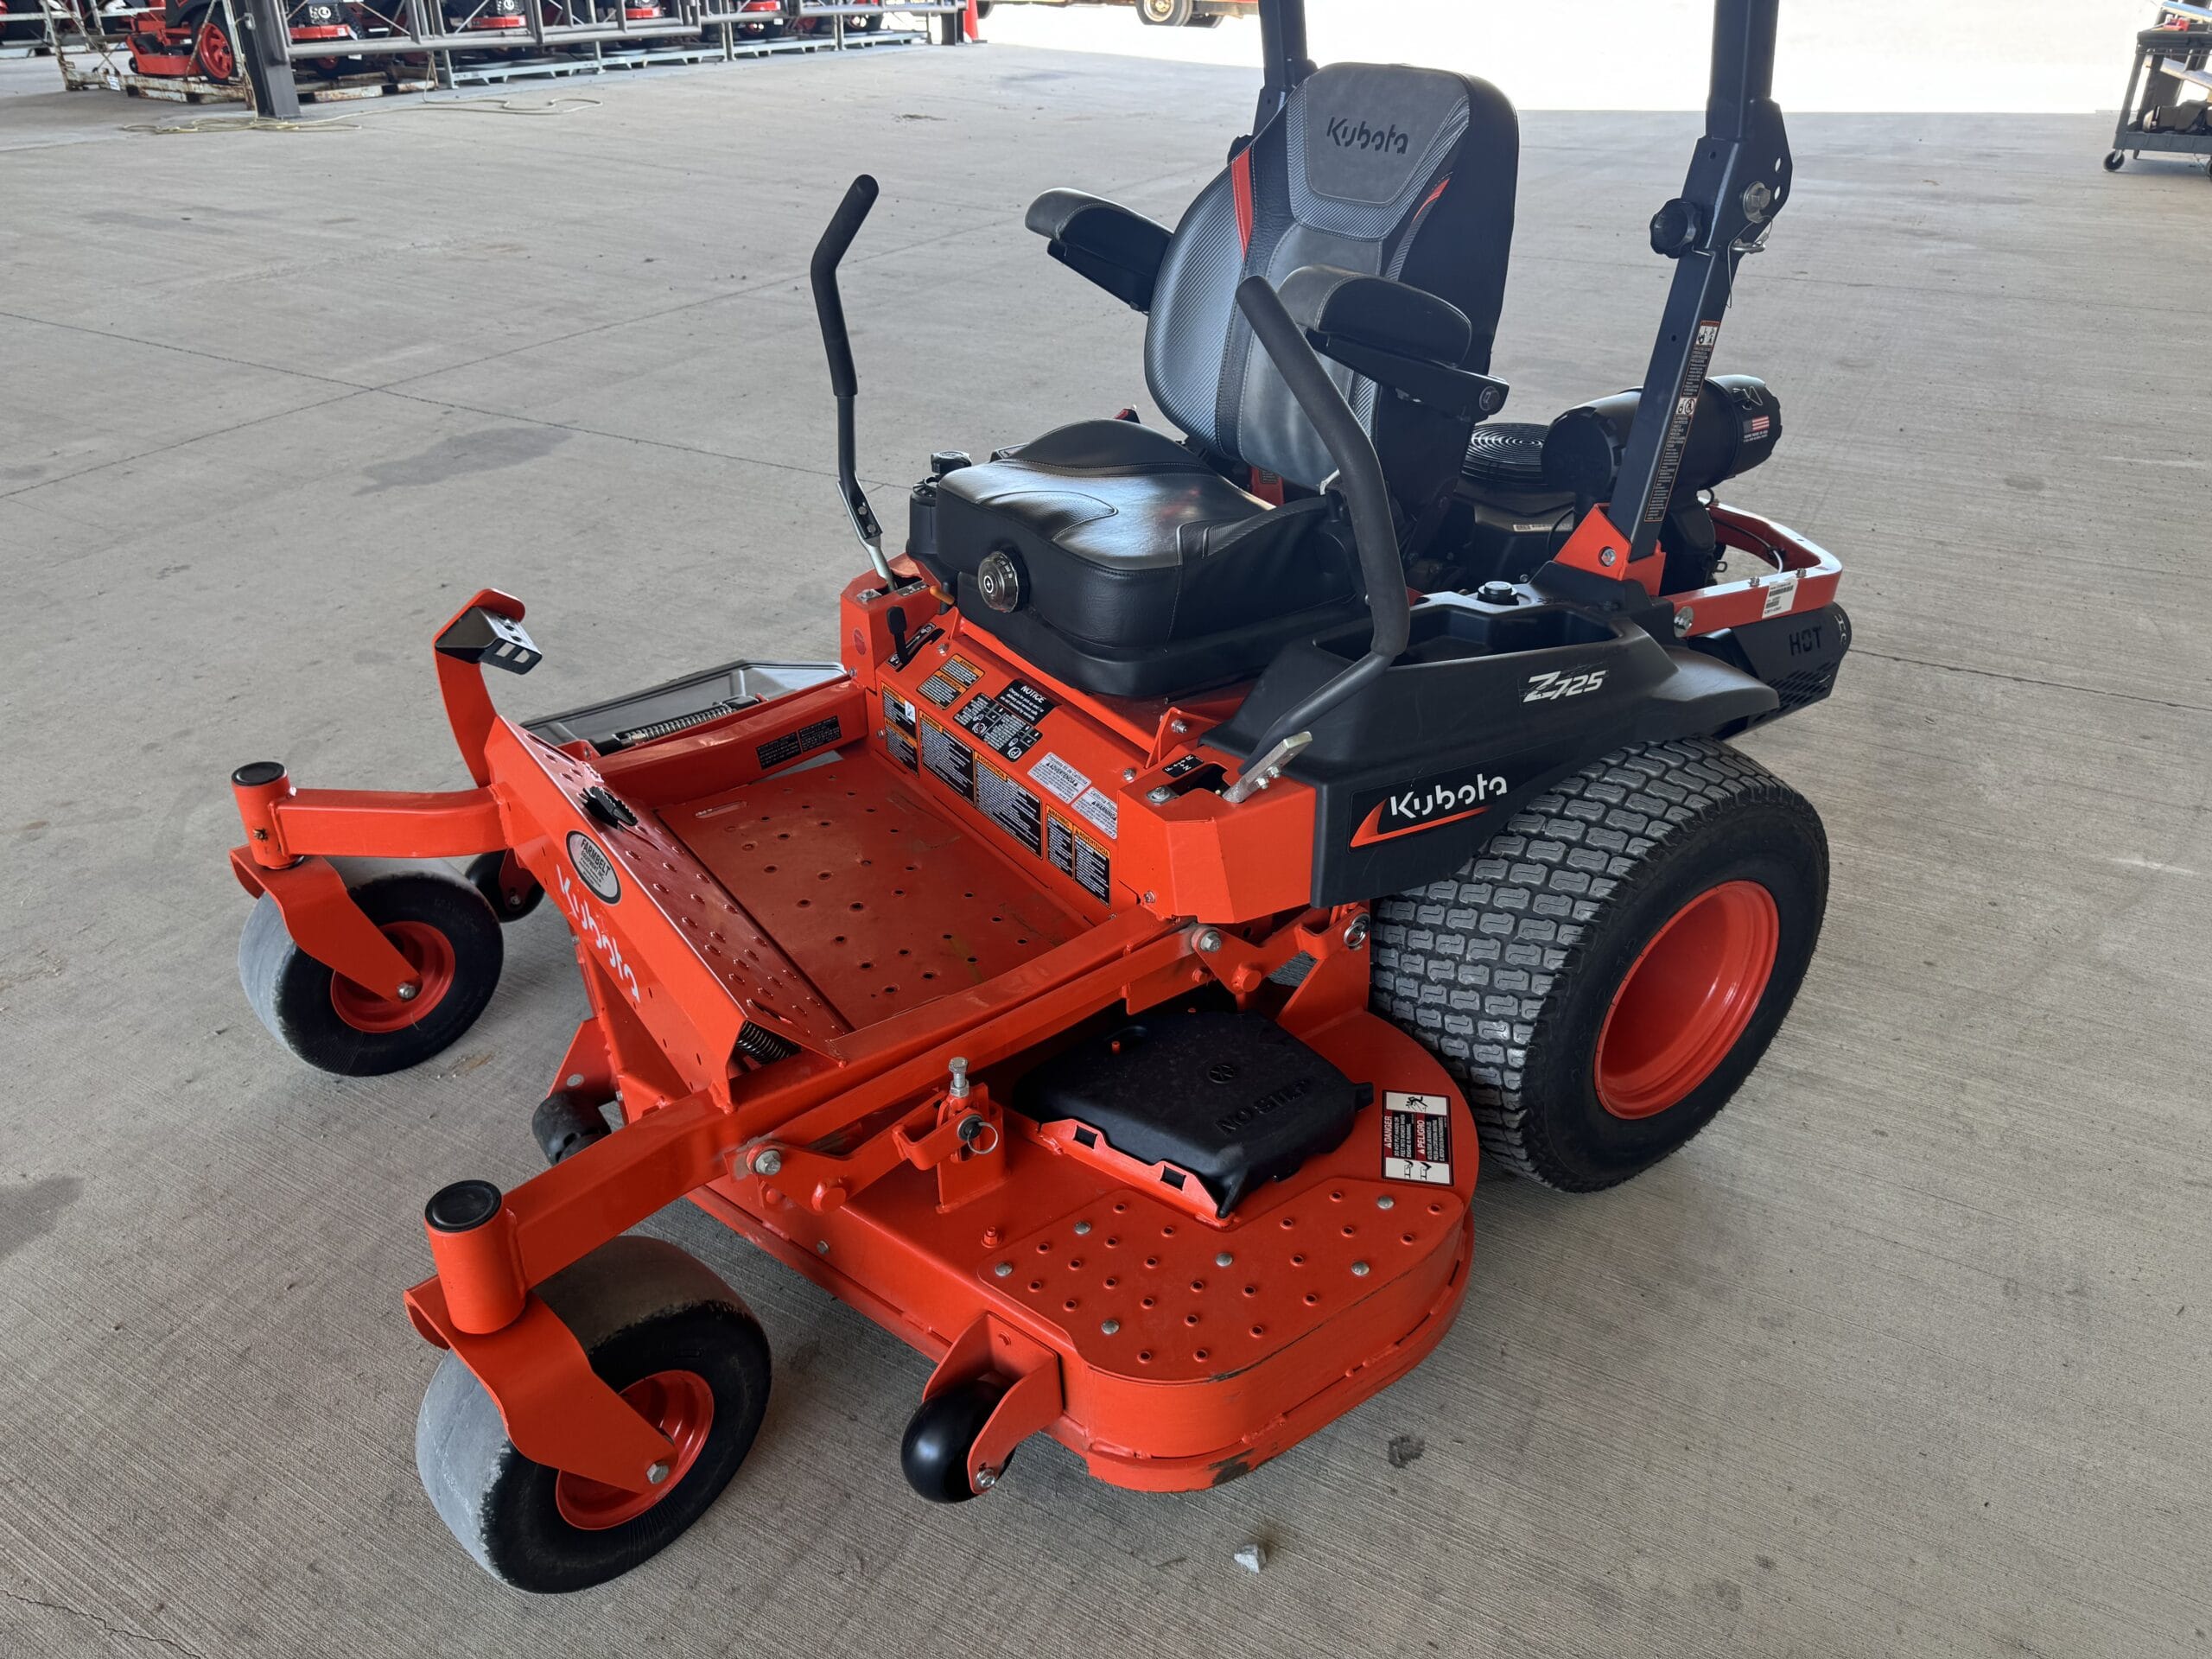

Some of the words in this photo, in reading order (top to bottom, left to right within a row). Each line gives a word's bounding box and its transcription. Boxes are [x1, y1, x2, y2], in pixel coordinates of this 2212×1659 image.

[1326, 117, 1408, 155] Kubota
[1789, 626, 1821, 656] HOT
[1020, 685, 1046, 703] NOTICE
[1522, 670, 1607, 702] Z725
[1390, 773, 1507, 818] Kubota
[581, 838, 611, 876] FARMBELT
[582, 850, 598, 873] EQUIPMENT
[556, 864, 640, 1003] Kubota
